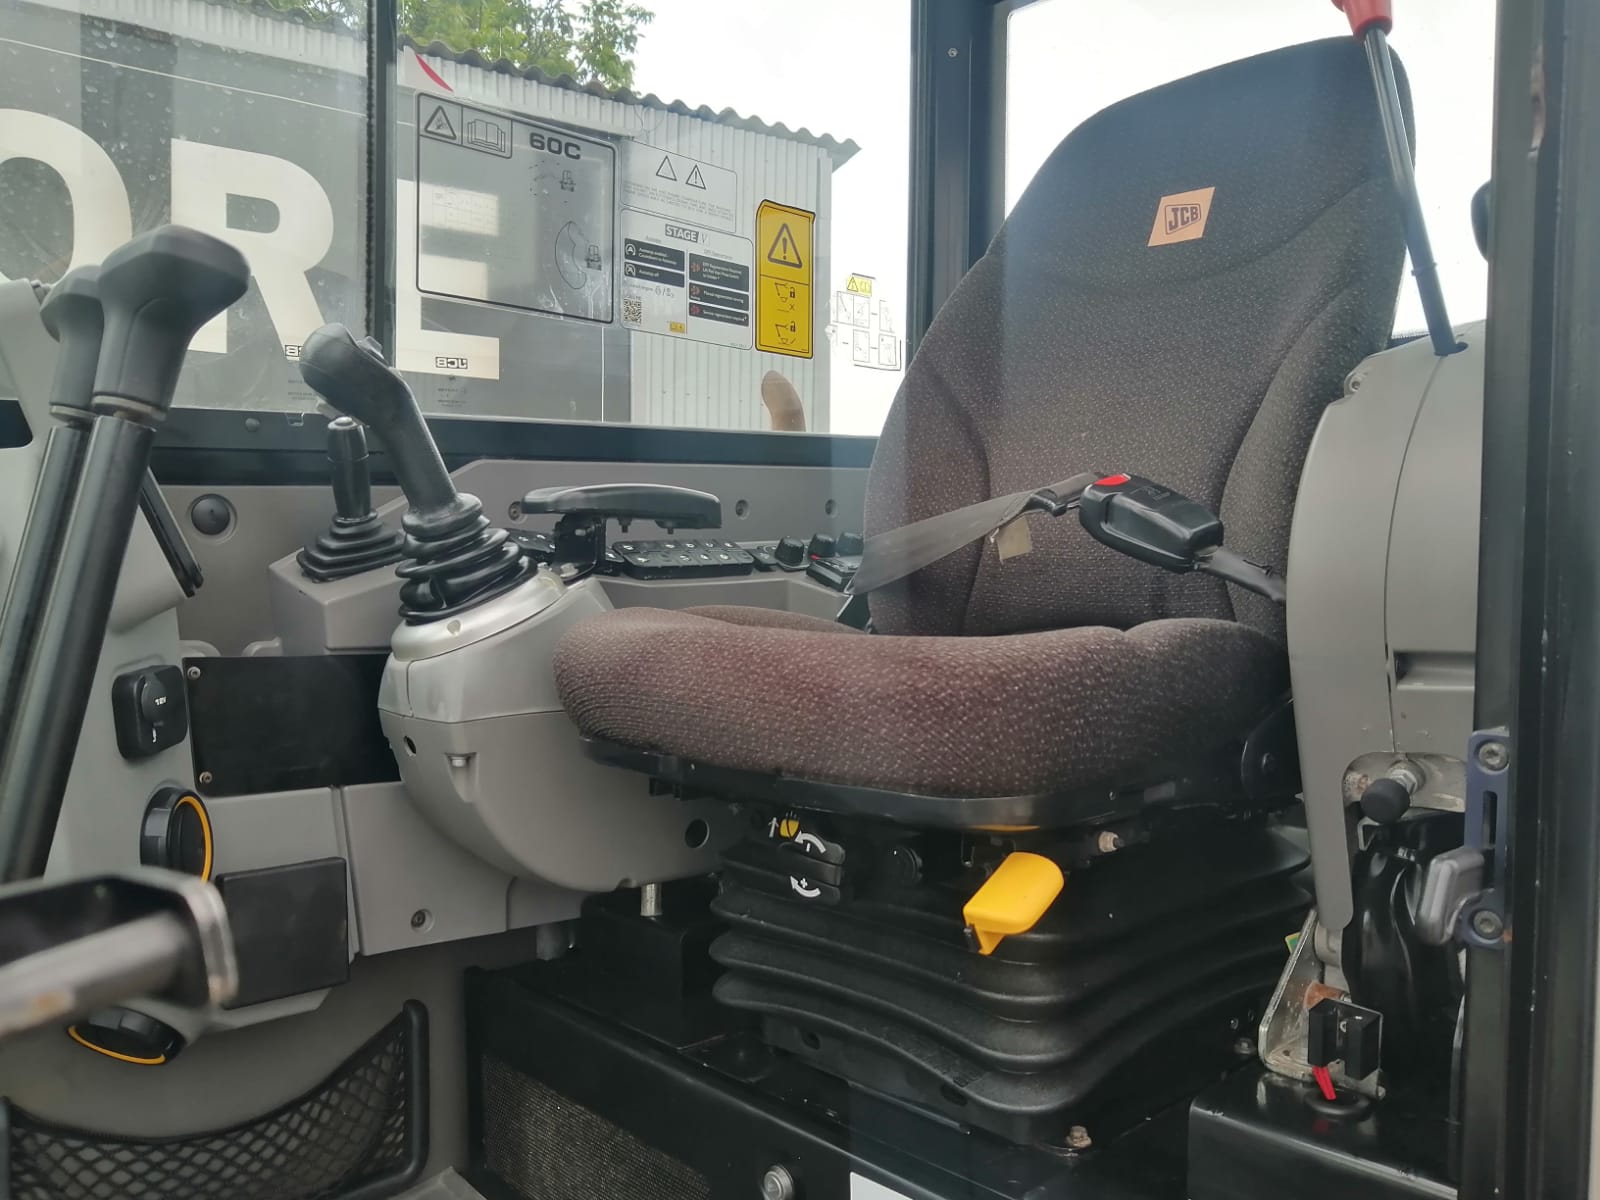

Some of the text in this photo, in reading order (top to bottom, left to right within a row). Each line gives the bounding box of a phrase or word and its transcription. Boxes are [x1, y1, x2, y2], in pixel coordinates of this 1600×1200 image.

[530, 132, 581, 160] 60C
[1167, 206, 1200, 231] JCB
[665, 224, 699, 243] STAGE
